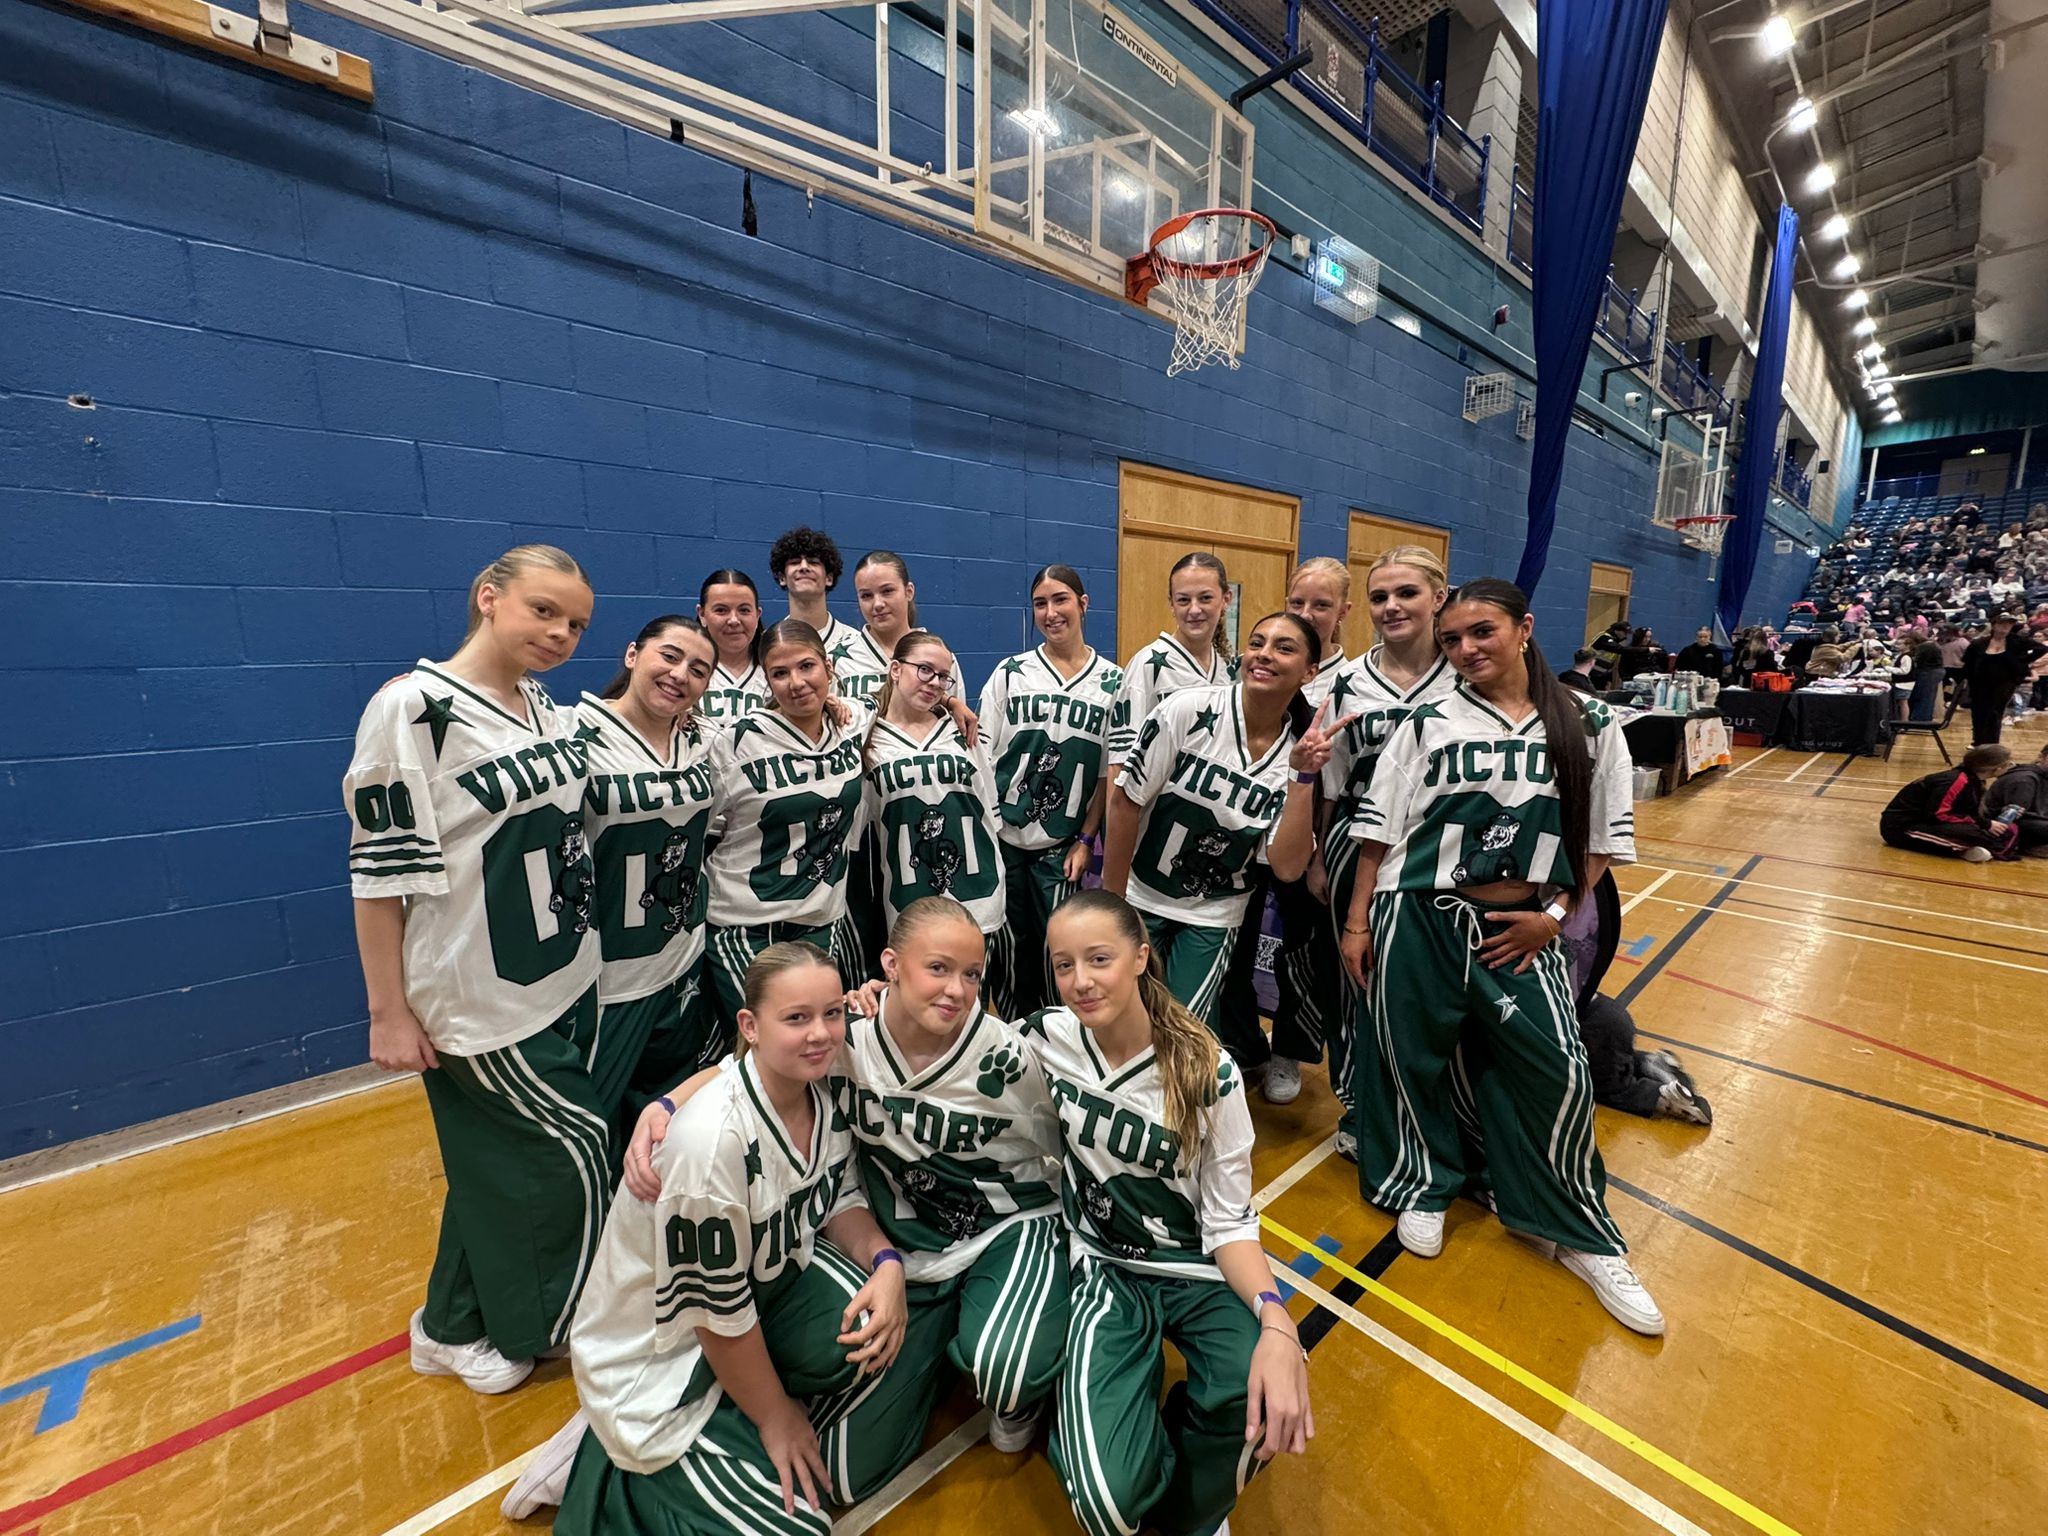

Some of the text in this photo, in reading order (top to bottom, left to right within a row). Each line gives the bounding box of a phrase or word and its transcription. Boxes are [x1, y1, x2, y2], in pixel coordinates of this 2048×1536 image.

[1104, 18, 1175, 84] CONTINENTAL
[1006, 693, 1109, 737] VICTOR
[355, 781, 416, 833] 00
[1169, 750, 1287, 821] VICTOR
[665, 1214, 737, 1271] 00
